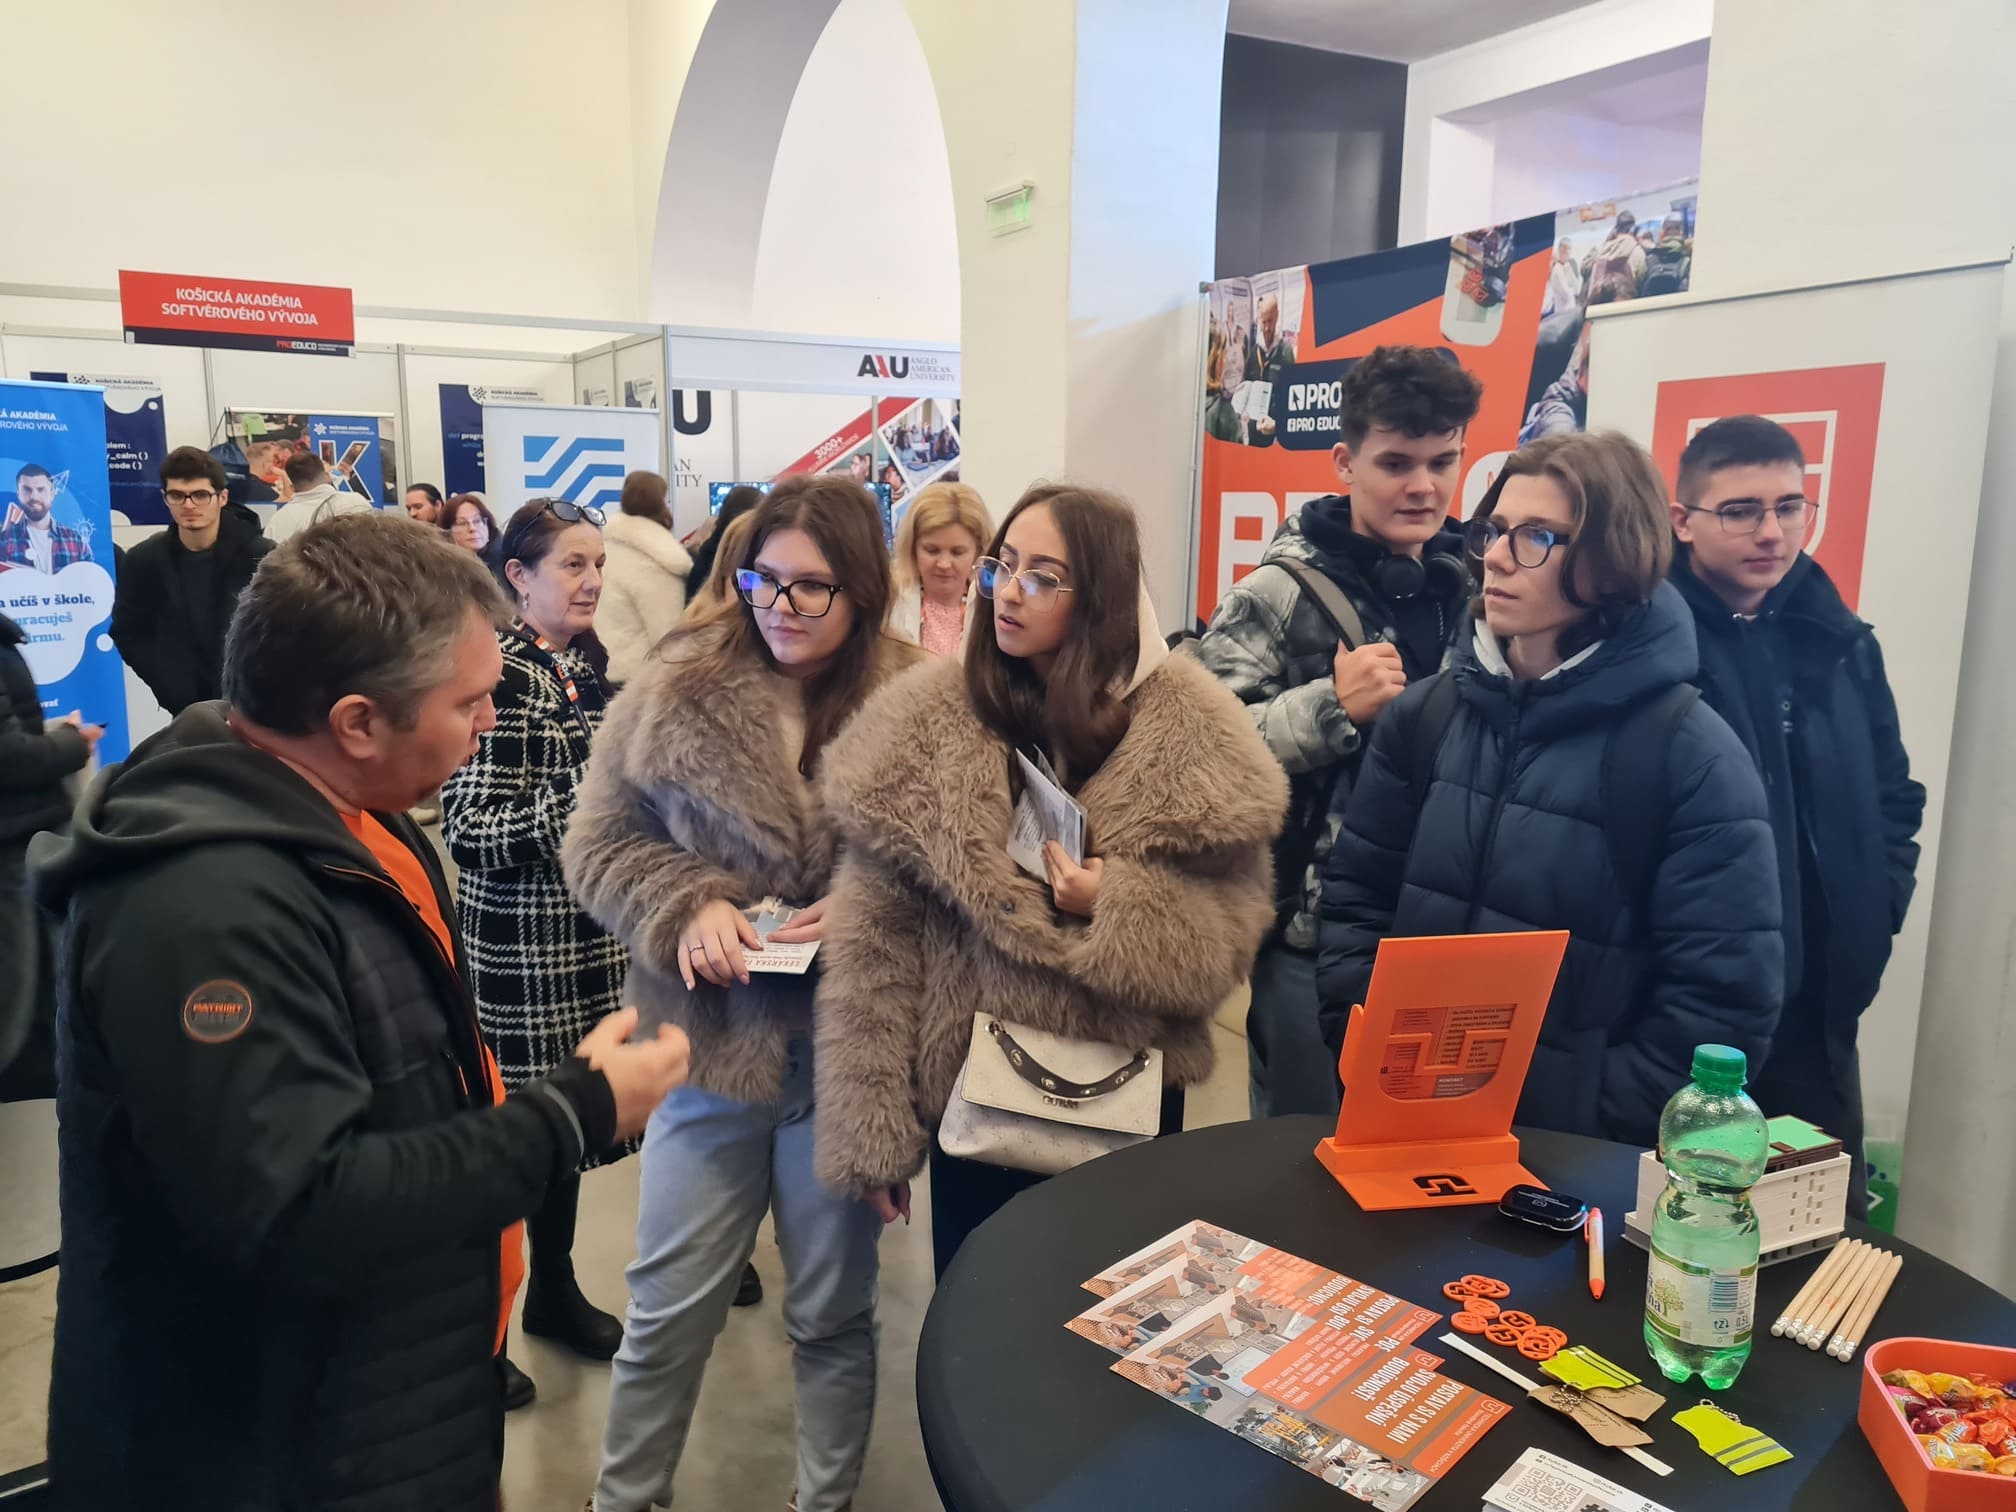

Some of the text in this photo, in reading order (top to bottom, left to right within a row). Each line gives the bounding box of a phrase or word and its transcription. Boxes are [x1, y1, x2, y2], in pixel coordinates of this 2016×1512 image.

[176, 287, 303, 309] KOŠICKÁ AKADÉMIA
[161, 302, 319, 325] SOFTVÉROVÉHO VÝVOJA
[10, 410, 56, 421] AKADÉMIA
[36, 421, 68, 431] VÝVOJA
[1296, 416, 1341, 432] PRO EDUC
[814, 436, 843, 459] 3000+
[10, 595, 38, 607] učíš
[42, 597, 51, 606] v
[54, 593, 95, 606] škole,
[1363, 1294, 1400, 1319] POSTAV
[1351, 1357, 1410, 1400] BUDÚCNOSŤ!
[1365, 1368, 1437, 1427] SVOJU ÚSPEŠNÚ
[1386, 1379, 1464, 1444] POSTAV SI S NAMI
